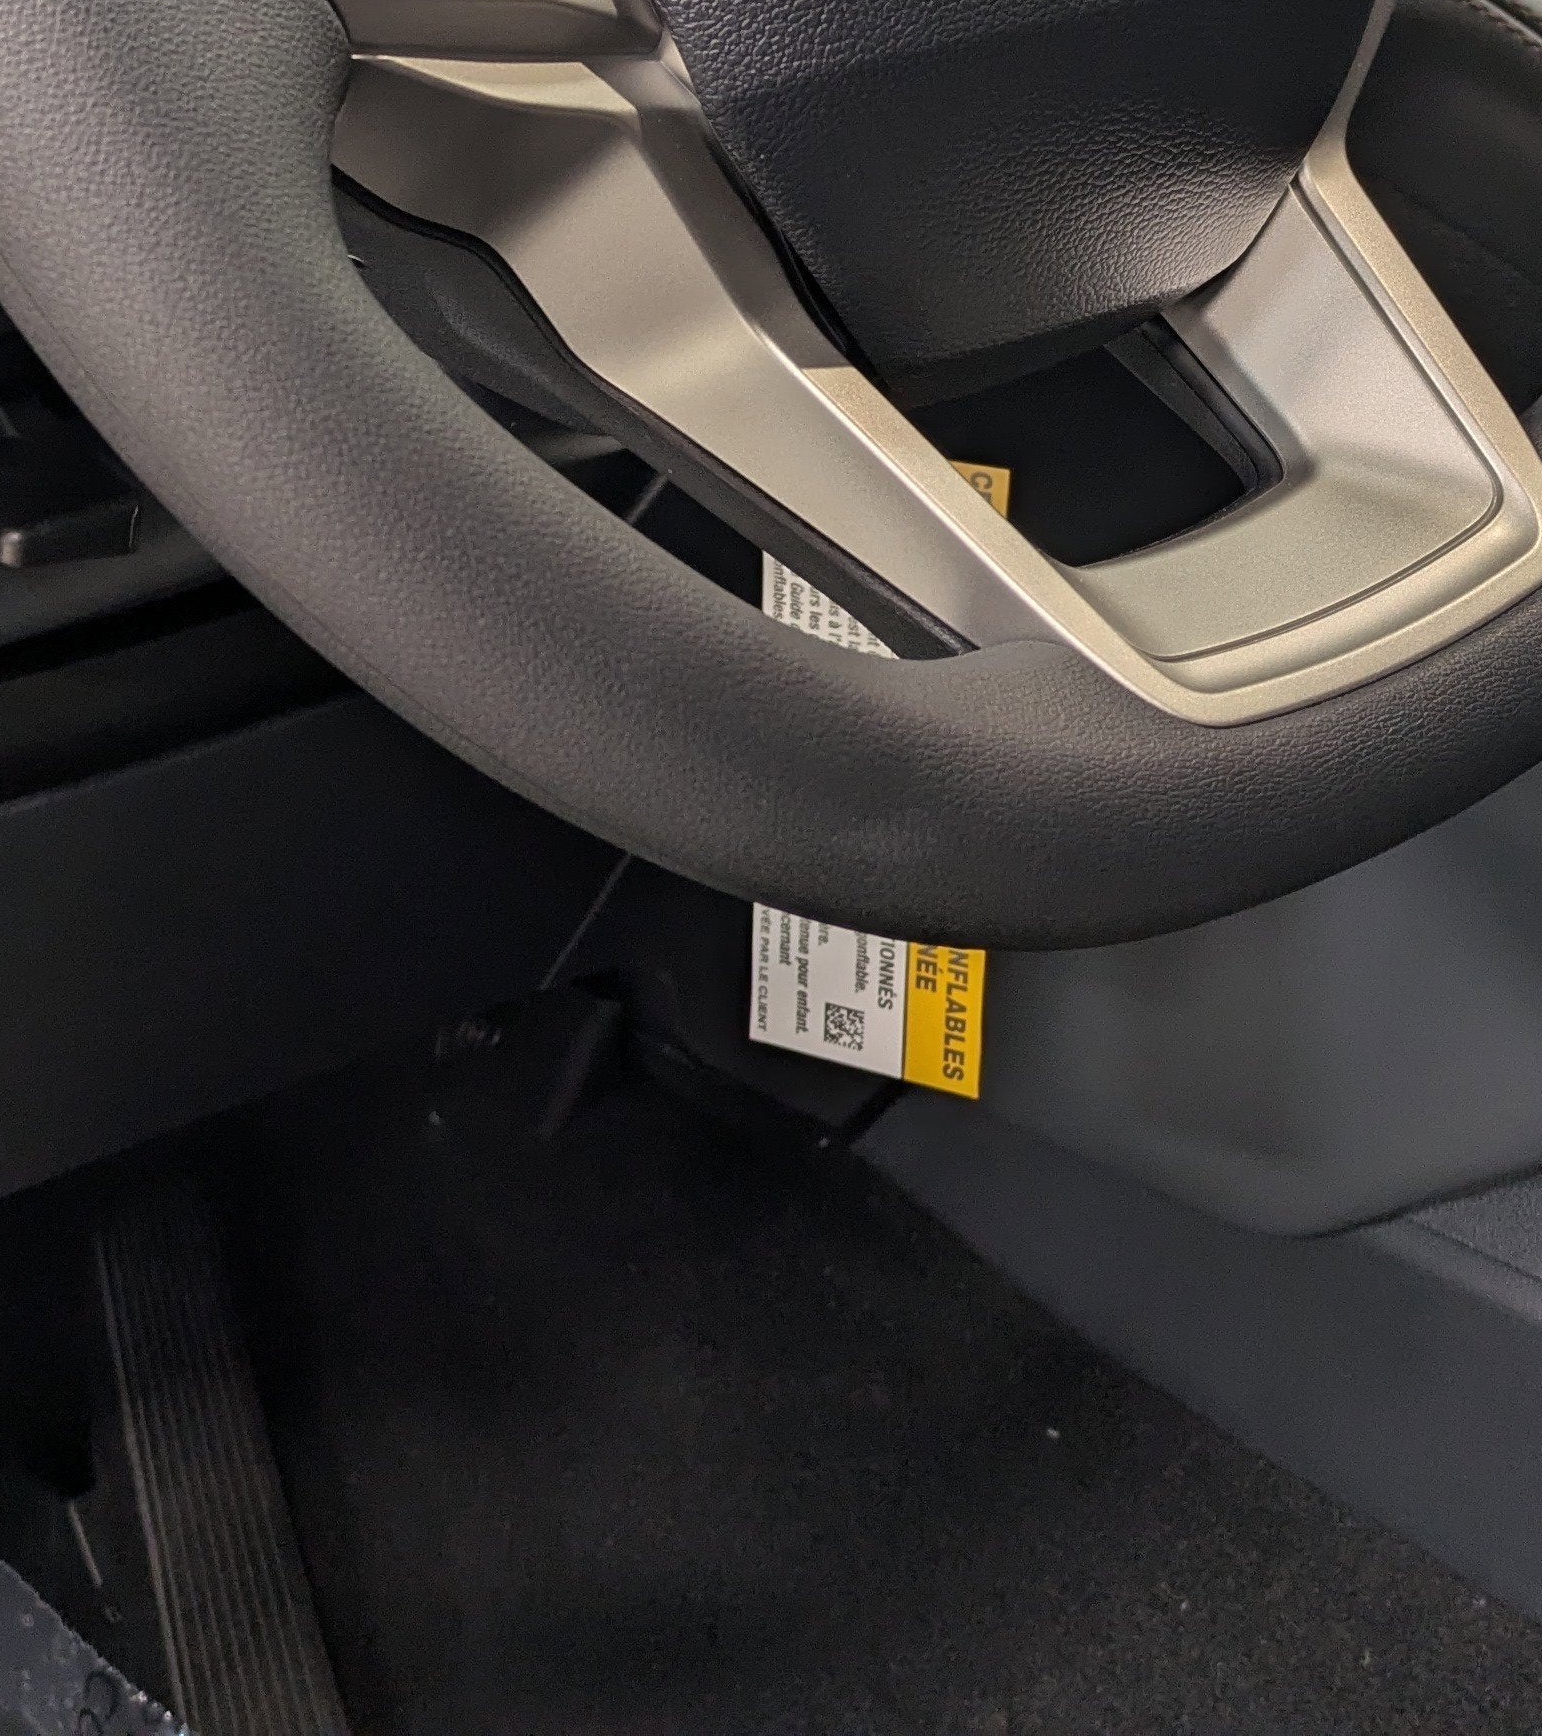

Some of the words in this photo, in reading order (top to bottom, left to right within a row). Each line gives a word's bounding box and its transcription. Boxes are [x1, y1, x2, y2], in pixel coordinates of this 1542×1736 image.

[790, 582, 804, 620] Guide
[760, 936, 770, 963] PAR
[759, 965, 769, 982] LE
[796, 956, 809, 988] pour
[877, 939, 897, 1011] IONNÉS
[758, 985, 768, 1032] CLIENT
[795, 990, 811, 1034] enfant.
